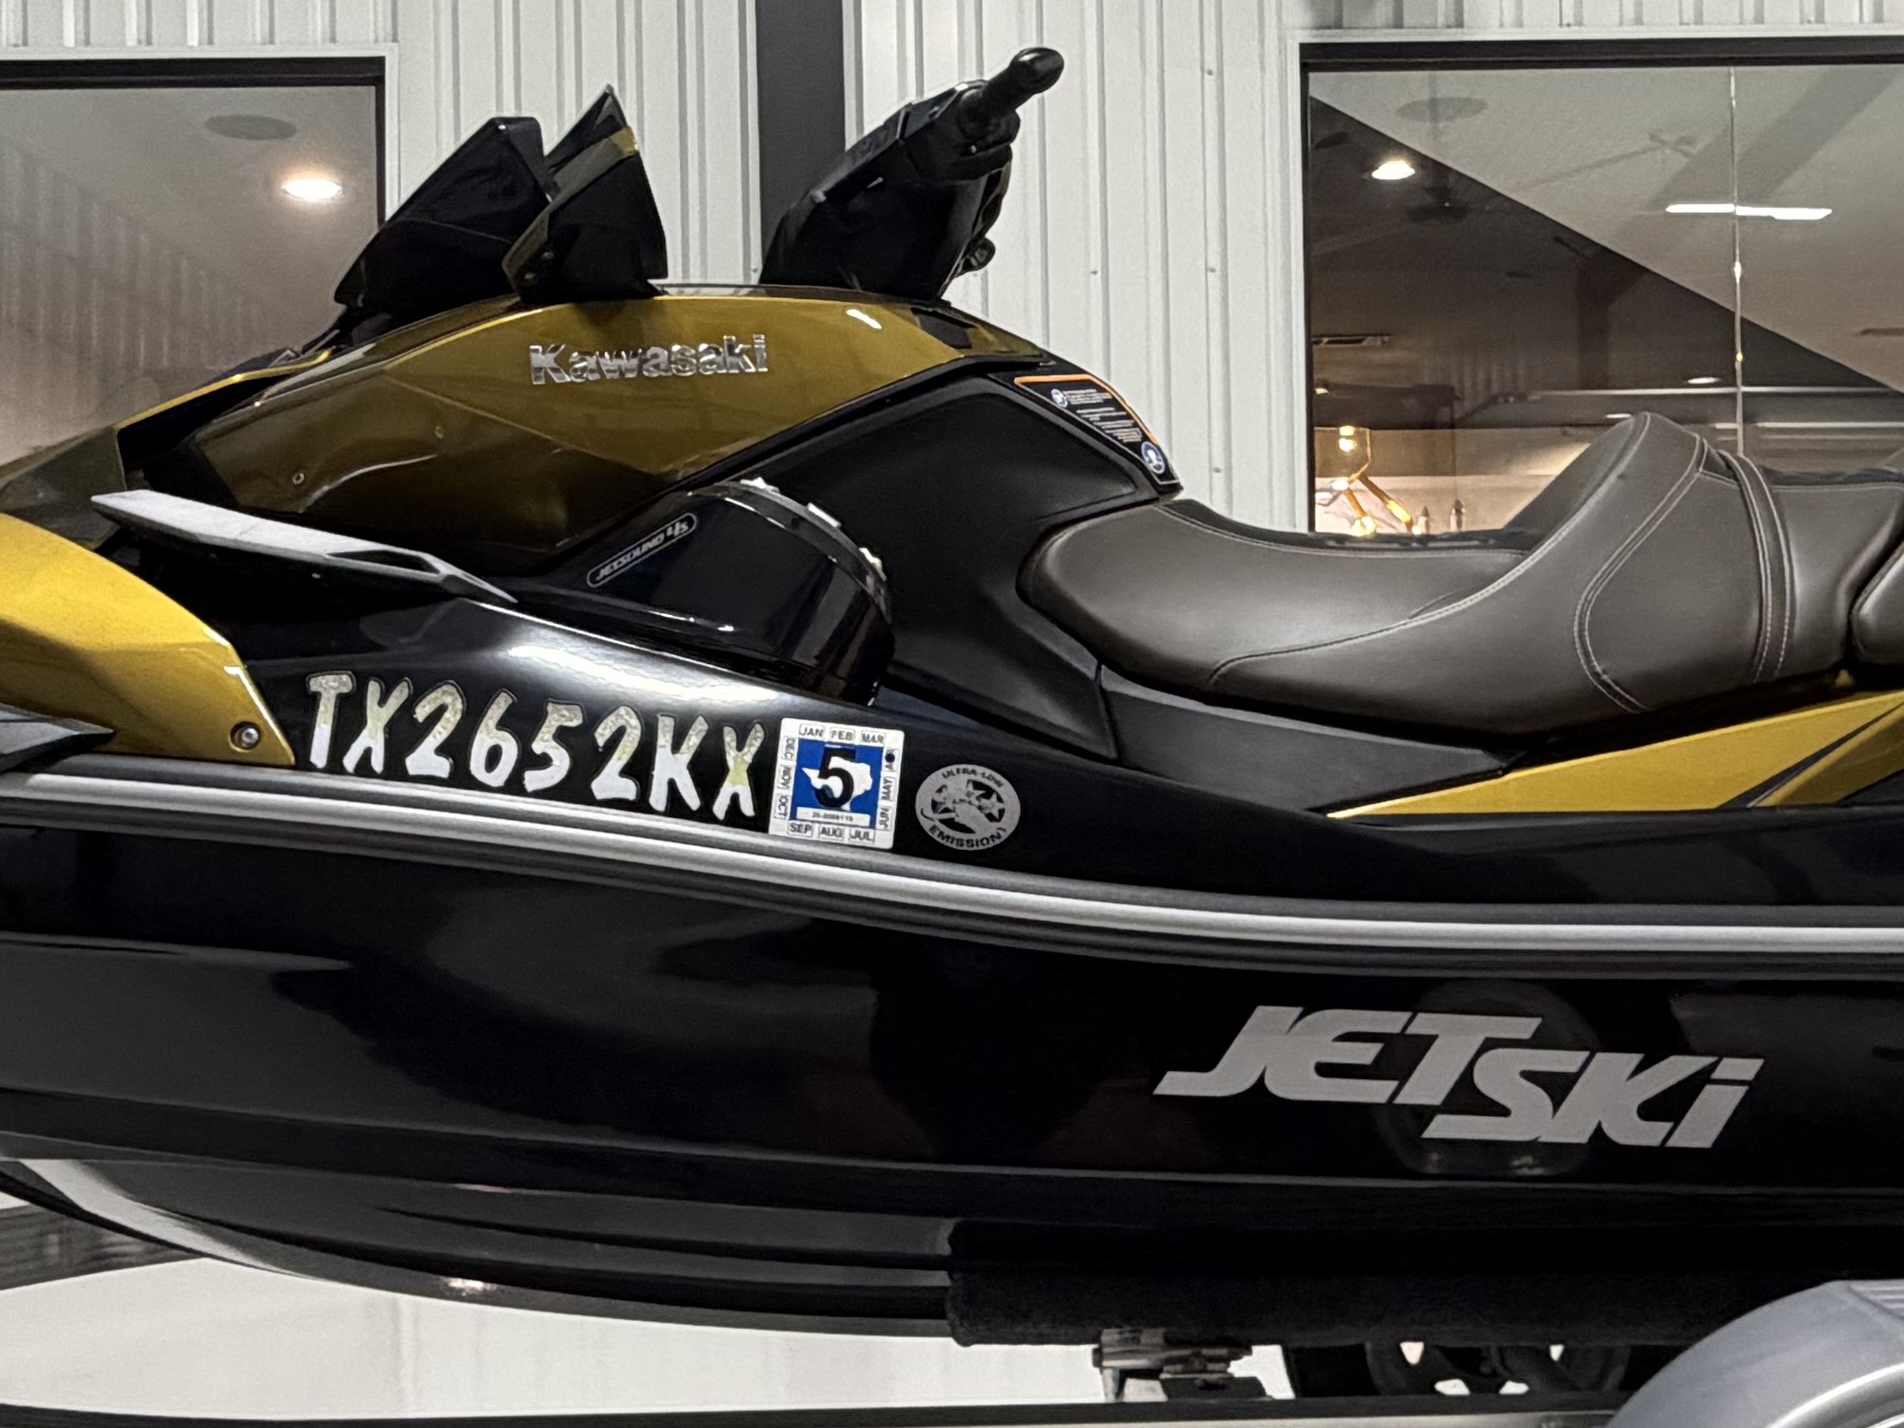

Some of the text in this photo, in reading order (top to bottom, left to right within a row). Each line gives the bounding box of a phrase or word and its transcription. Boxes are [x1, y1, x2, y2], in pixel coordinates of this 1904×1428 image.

[529, 334, 768, 385] Kawasaki
[306, 671, 765, 821] TX2652KX
[801, 726, 884, 743] JAN FEB MAR
[784, 737, 795, 760] DEC
[780, 765, 791, 789] NOV
[815, 745, 856, 809] 5
[881, 777, 893, 800] MAY
[778, 794, 788, 817] OCT
[879, 807, 890, 829] JUN
[790, 823, 873, 841] SEP AUG JUL
[929, 824, 1002, 848] EMISSION
